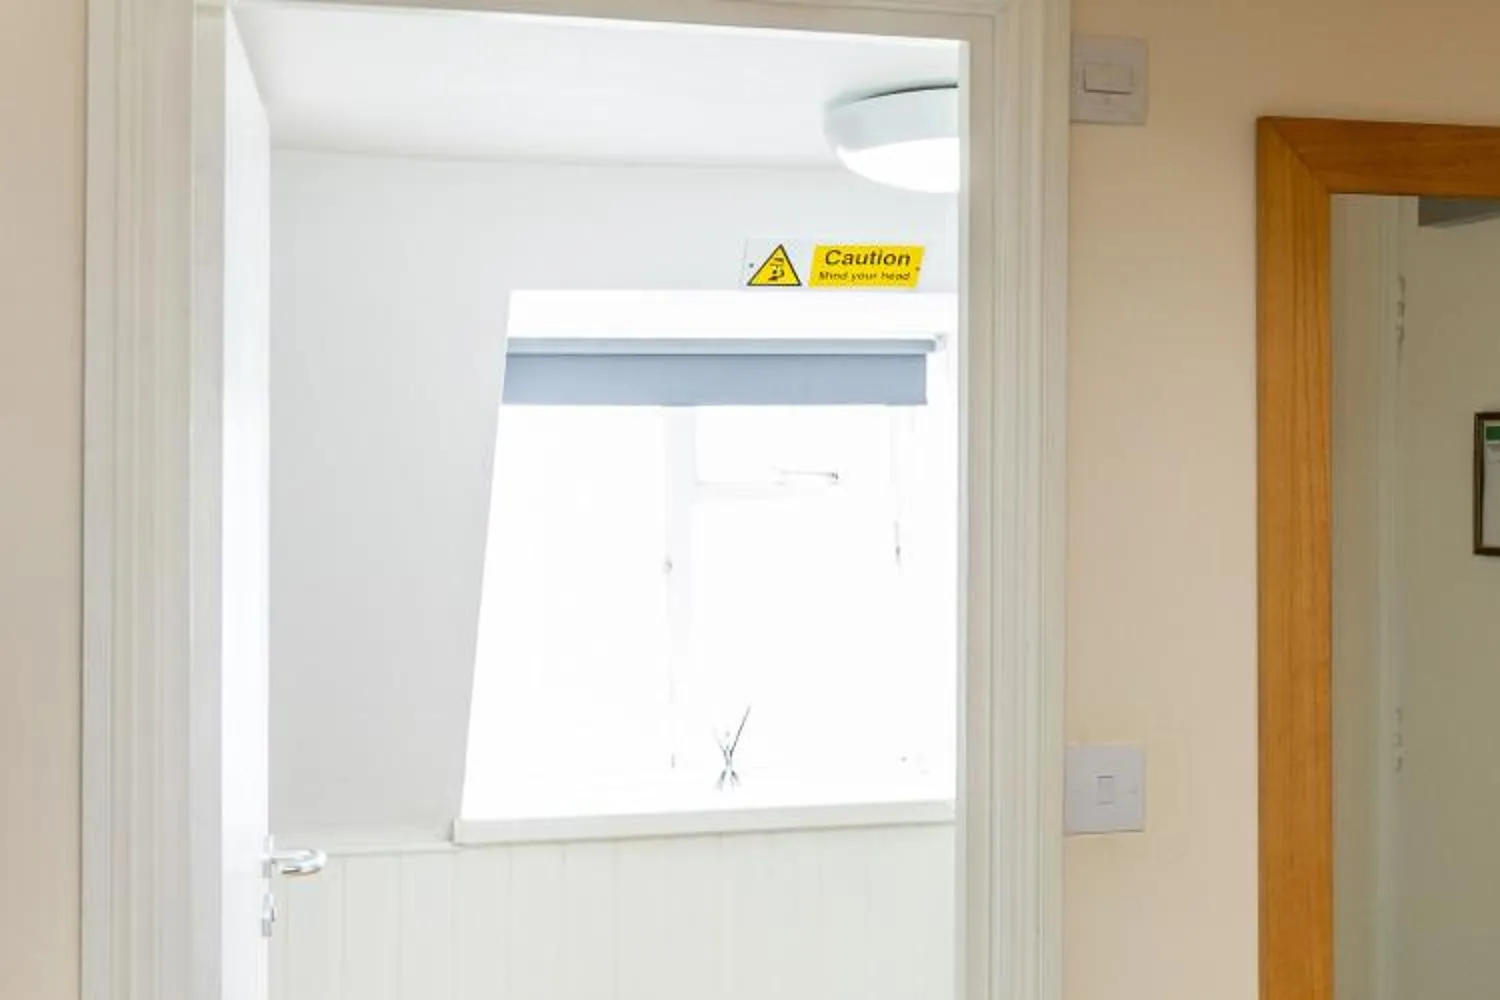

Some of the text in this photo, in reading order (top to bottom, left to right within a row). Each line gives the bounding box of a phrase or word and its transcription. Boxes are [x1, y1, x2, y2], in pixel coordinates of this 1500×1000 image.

[825, 248, 911, 266] Caution
[819, 271, 910, 282] Mind your head
